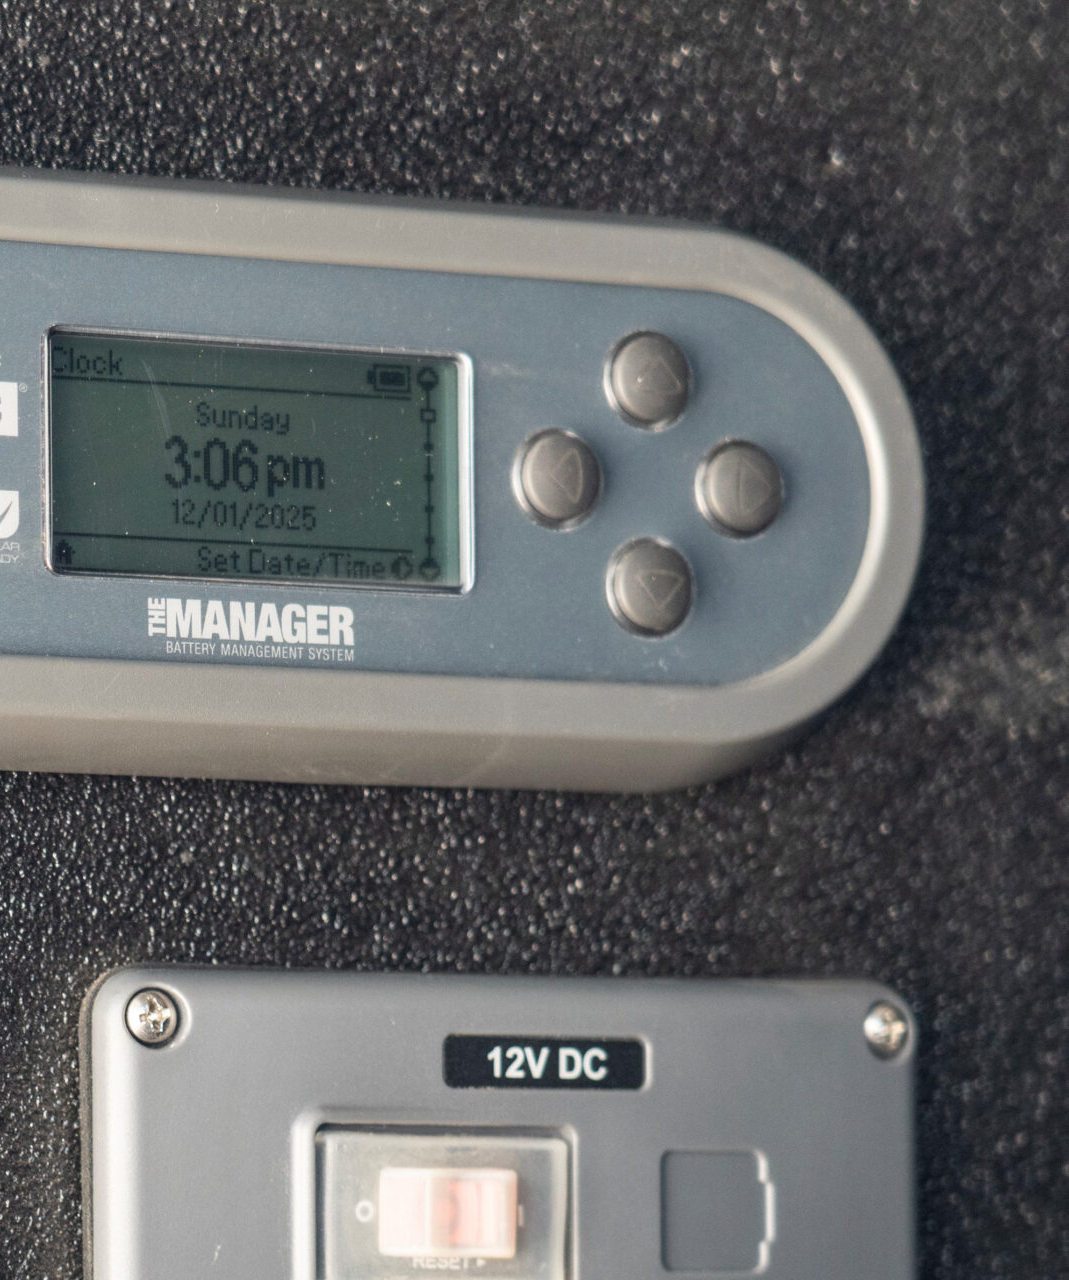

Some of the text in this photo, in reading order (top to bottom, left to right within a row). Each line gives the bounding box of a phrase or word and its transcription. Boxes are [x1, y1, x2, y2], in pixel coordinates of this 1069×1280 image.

[51, 346, 124, 377] Clock
[196, 402, 291, 436] Sunday
[172, 498, 318, 532] 12/01/2025
[197, 546, 386, 579] Set Date/Time
[148, 597, 355, 647] THE MANAGER
[166, 641, 355, 662] BATTERY MANAGEMENT SYSTEM
[486, 1046, 608, 1080] 12V DC
